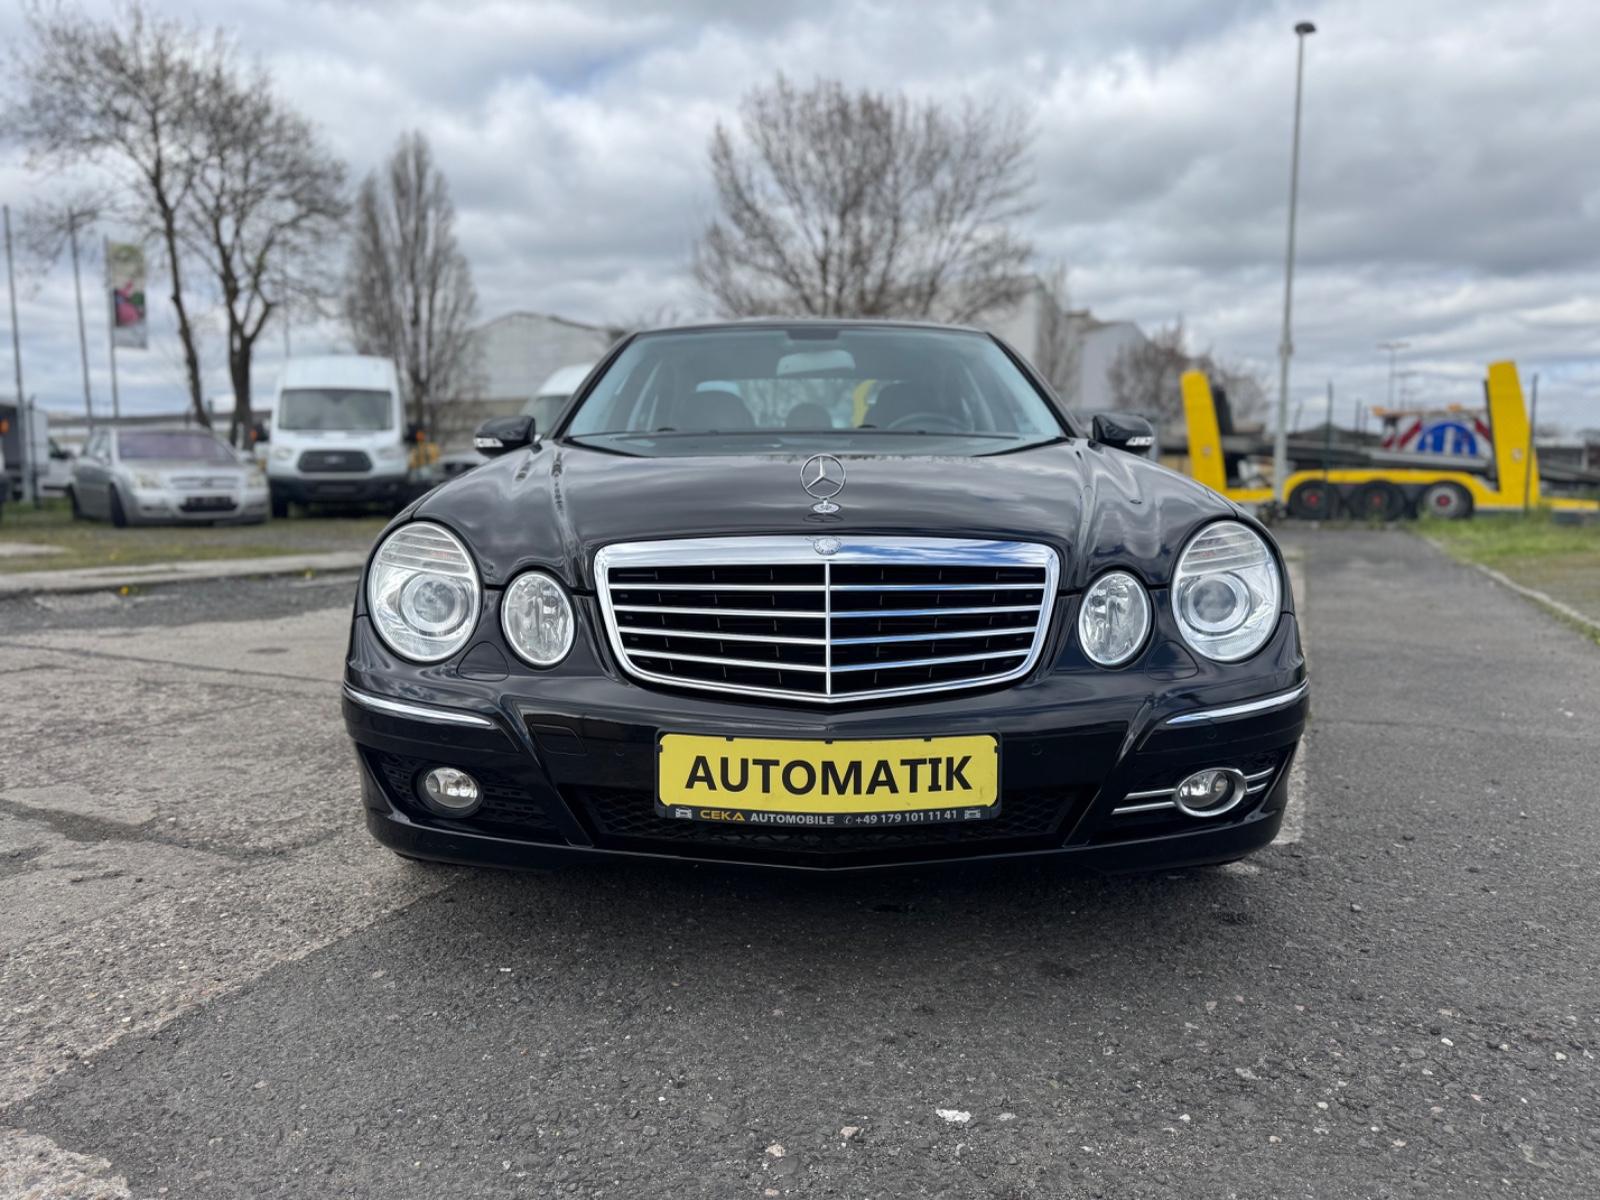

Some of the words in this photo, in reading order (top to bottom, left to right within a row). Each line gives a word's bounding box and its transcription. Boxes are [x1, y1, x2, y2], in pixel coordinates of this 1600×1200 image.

[685, 755, 973, 796] AUTOMATIK
[700, 809, 745, 822] CEKA
[751, 812, 835, 825] AUTOMOBILE
[855, 814, 878, 825] +49
[881, 813, 902, 823] 179
[904, 812, 924, 822] 101
[928, 811, 941, 821] 11
[944, 810, 957, 819] 41
